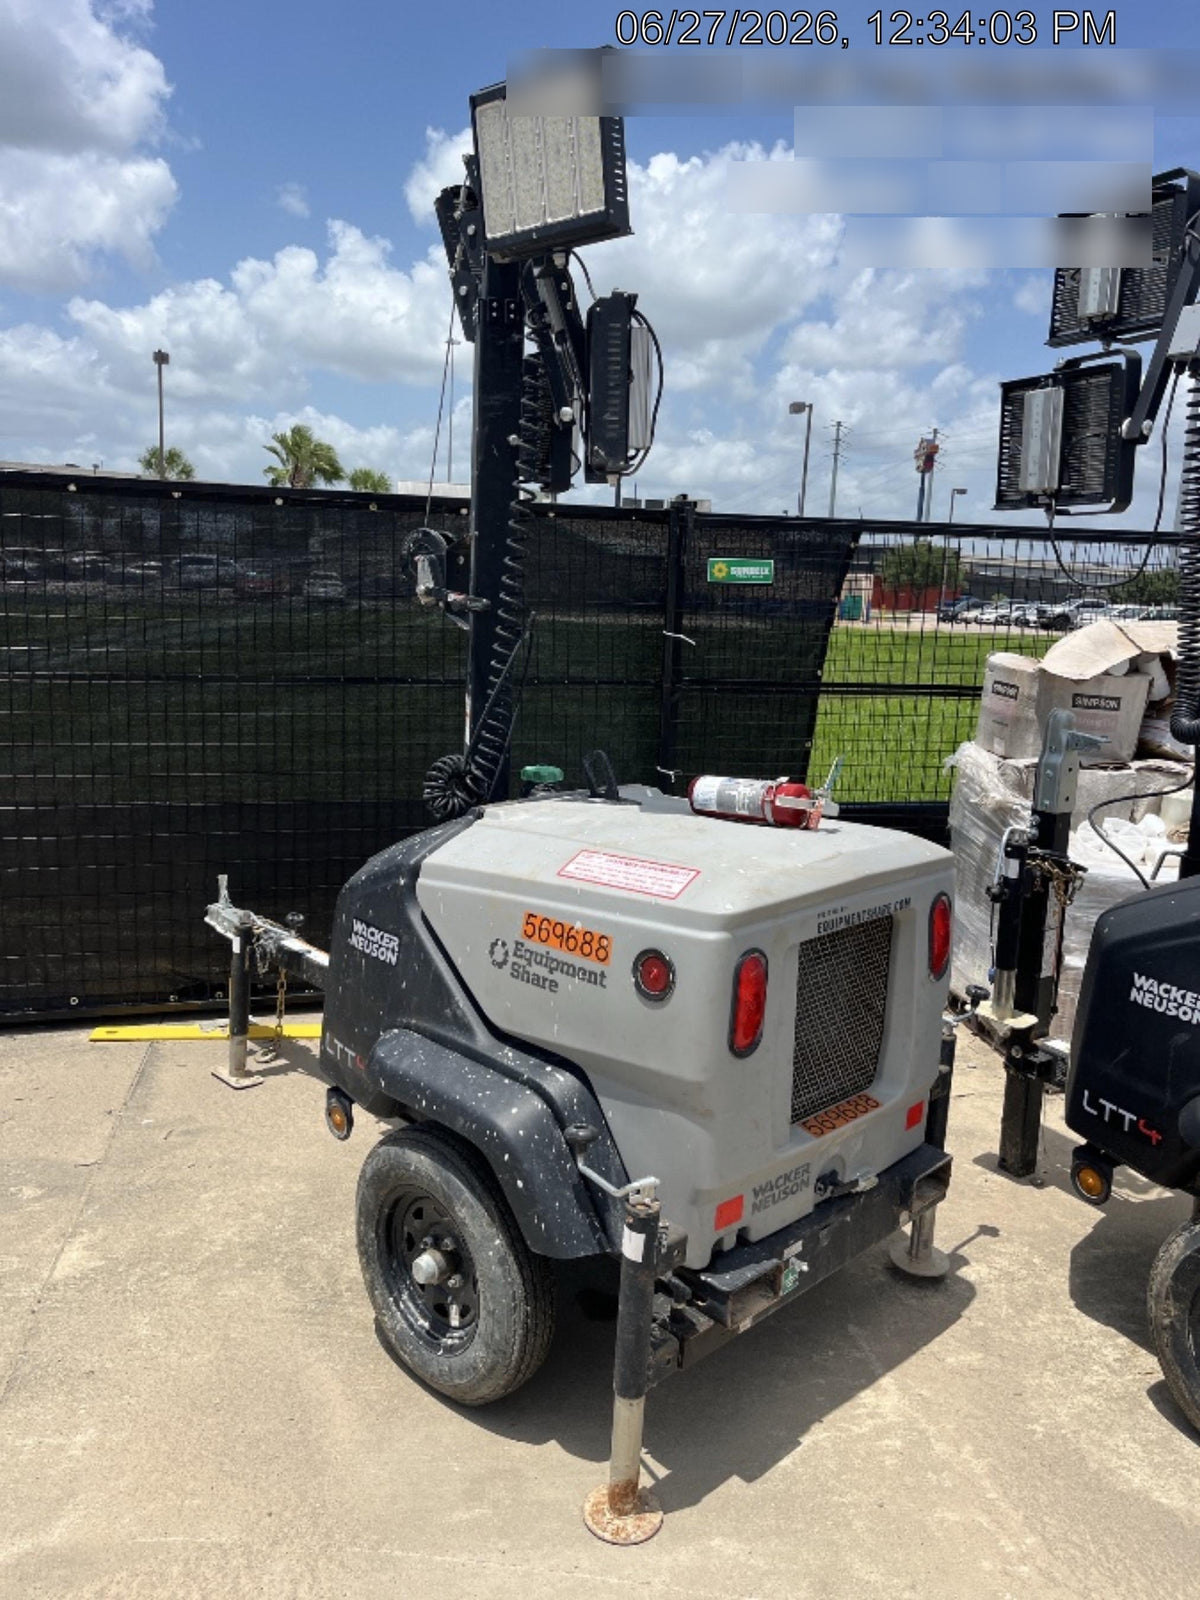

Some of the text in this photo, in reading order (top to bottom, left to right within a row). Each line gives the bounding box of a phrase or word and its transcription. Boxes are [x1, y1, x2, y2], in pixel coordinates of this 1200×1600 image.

[1074, 696, 1119, 709] SIMPSON
[350, 933, 399, 966] NEUSON
[352, 918, 400, 952] WACKER
[523, 913, 609, 963] 569688
[510, 961, 559, 994] Share
[512, 940, 607, 989] Equipment
[800, 1093, 880, 1136] 569688
[1082, 1089, 1162, 1146] LTT4
[751, 1175, 810, 1216] NEUSON
[752, 1162, 811, 1200] WACKER
